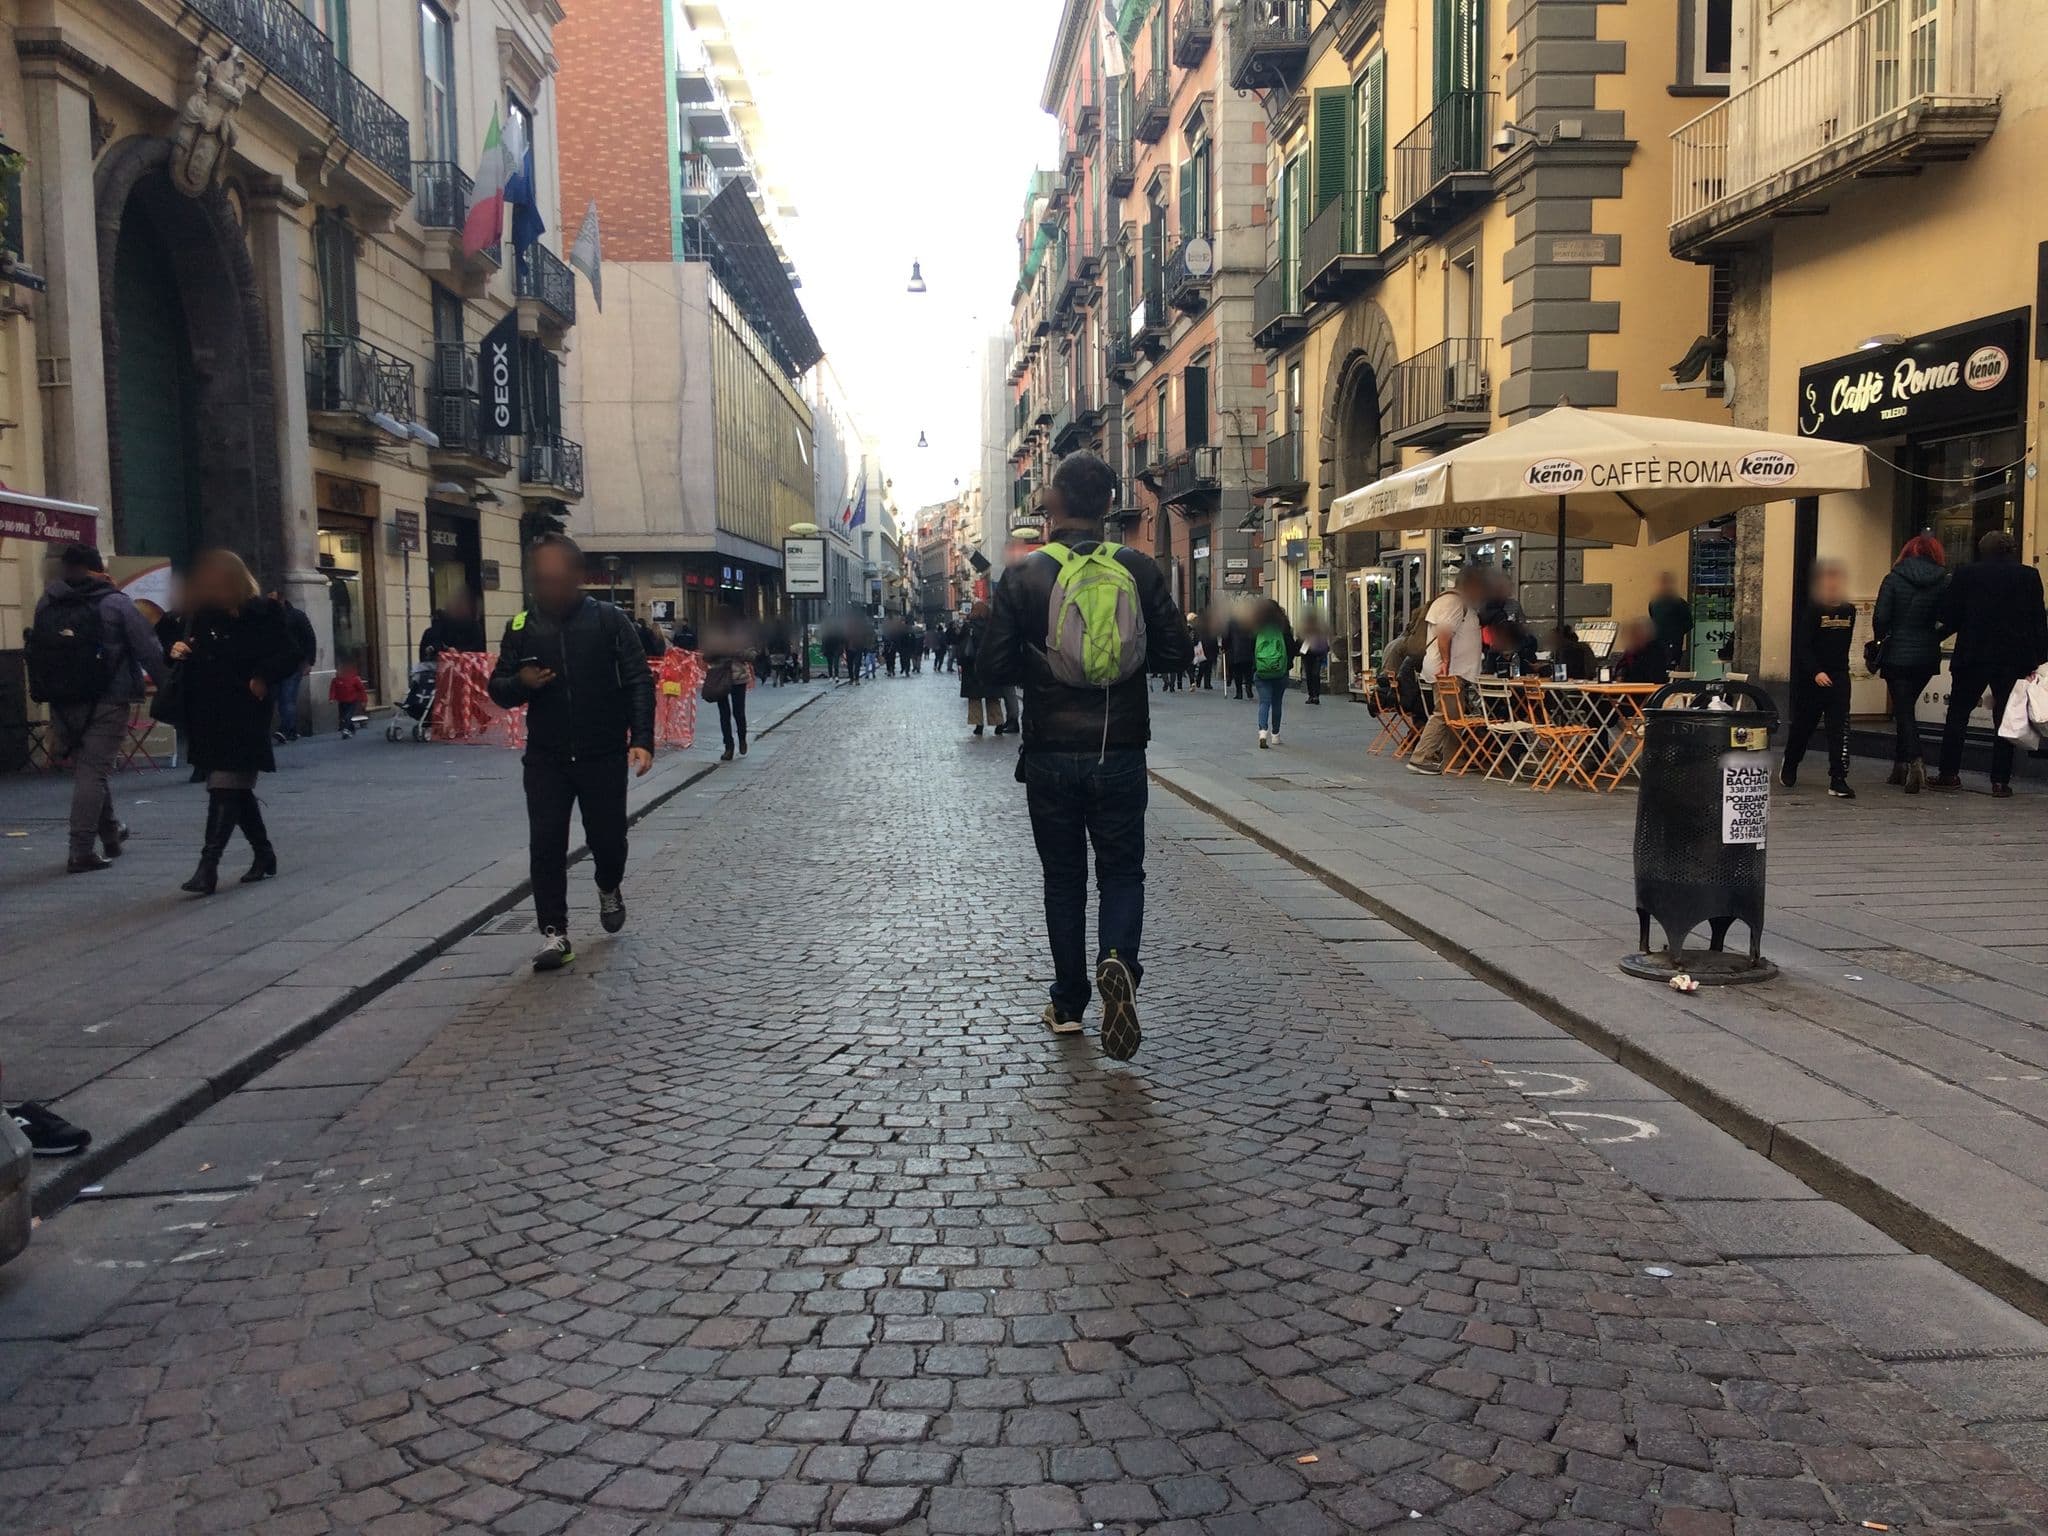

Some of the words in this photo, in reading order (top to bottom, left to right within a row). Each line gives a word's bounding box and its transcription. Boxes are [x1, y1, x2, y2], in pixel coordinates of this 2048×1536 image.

[1969, 360, 2002, 380] kenon
[493, 343, 510, 428] GEOX
[1831, 371, 1884, 416] Caffè
[1892, 358, 1960, 401] Roma
[1880, 406, 1908, 420] TOLEDO
[1591, 456, 1662, 486] CAFFÈ
[1668, 460, 1733, 483] ROMA
[1740, 457, 1796, 475] kenon
[1529, 467, 1584, 484] kenon
[1727, 766, 1768, 777] SALSA
[1726, 776, 1768, 786] BACHATA
[1739, 810, 1763, 818] YOGA
